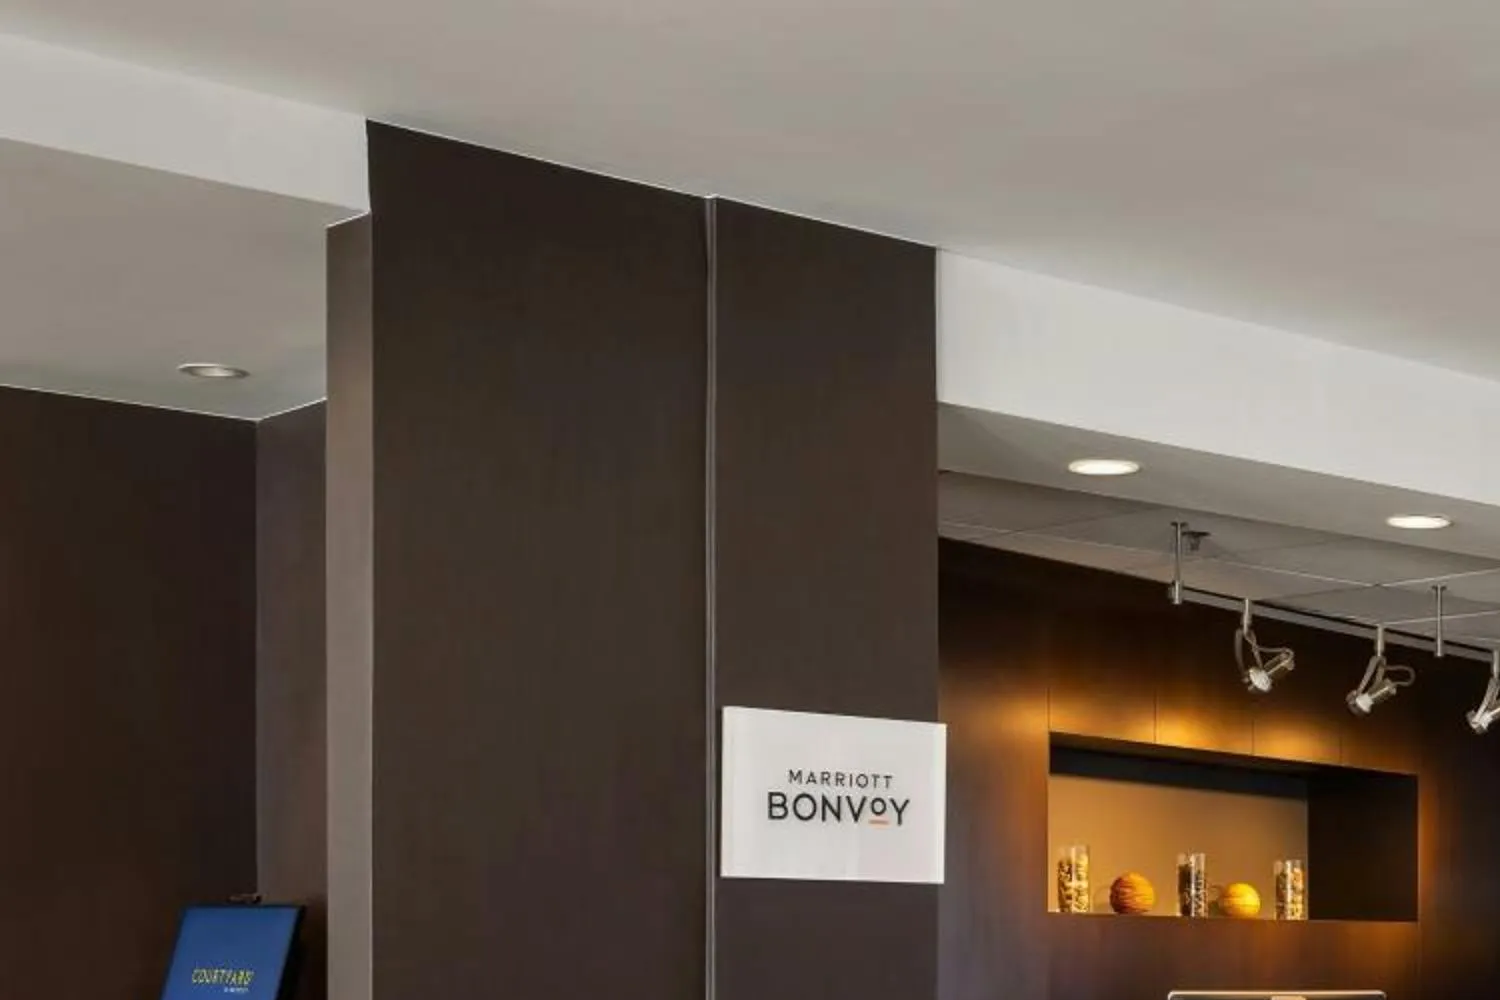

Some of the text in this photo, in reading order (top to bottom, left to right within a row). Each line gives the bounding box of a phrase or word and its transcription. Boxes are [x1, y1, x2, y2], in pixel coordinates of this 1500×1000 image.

[788, 769, 893, 789] MARRIOTT
[767, 792, 910, 826] BONVOY
[192, 969, 254, 986] COURTYARD
